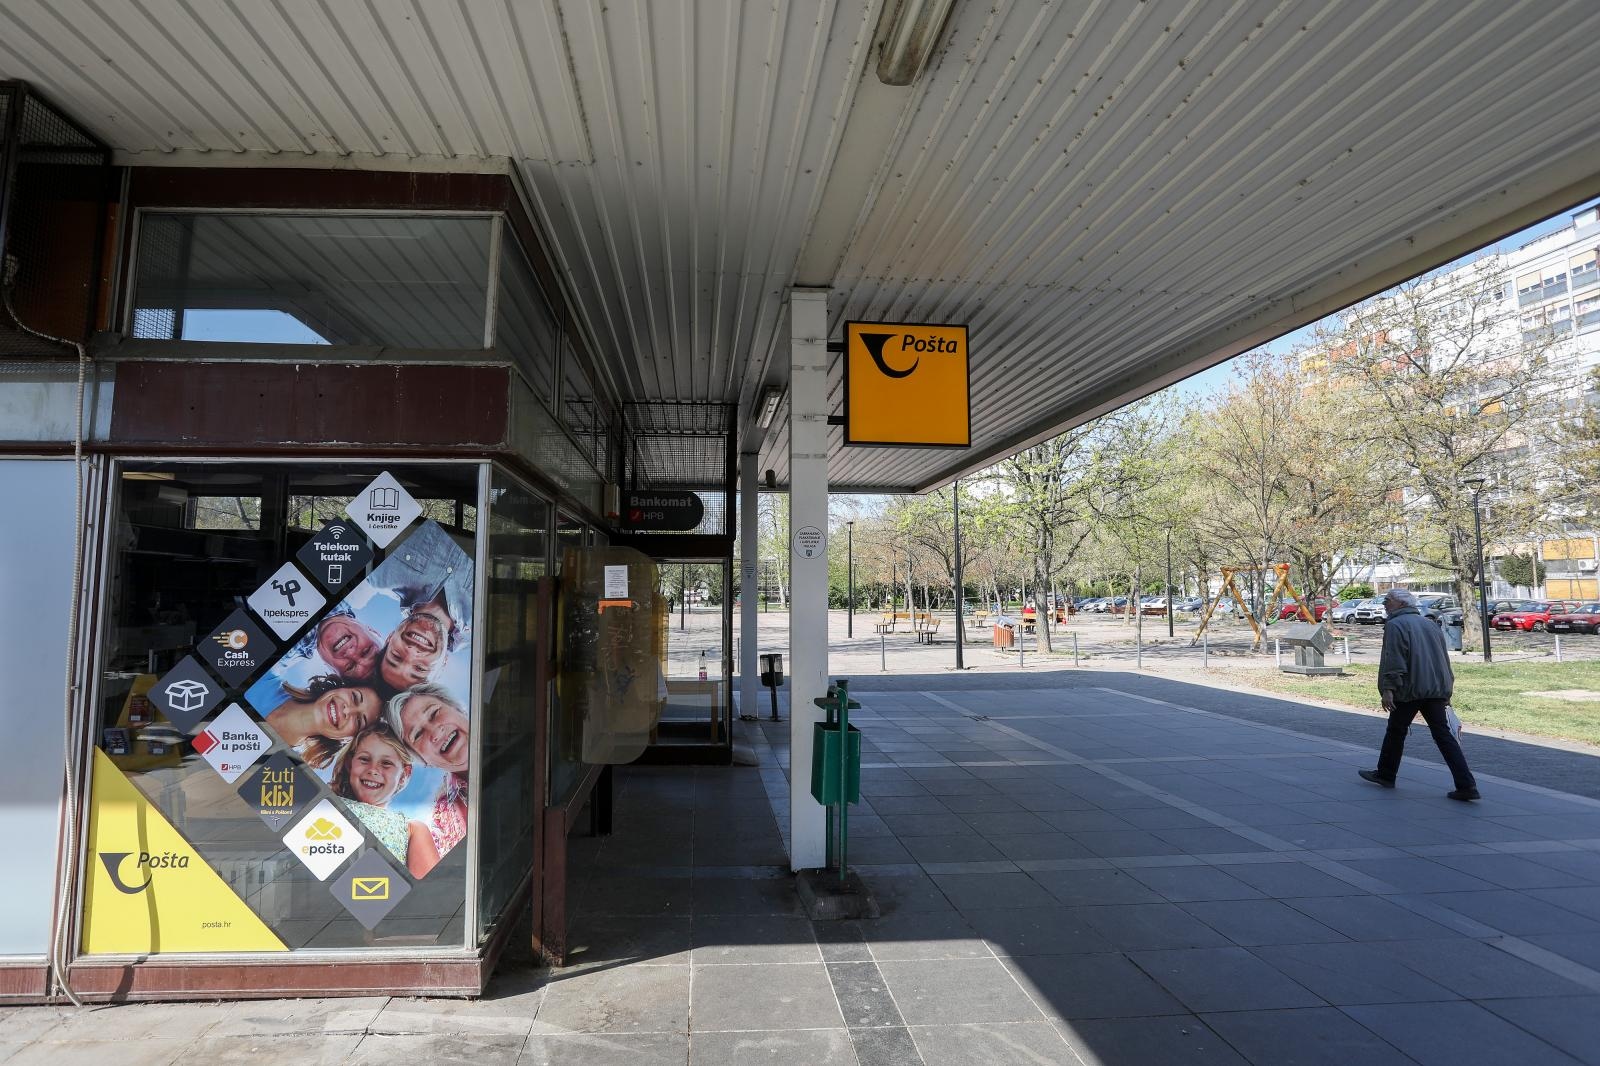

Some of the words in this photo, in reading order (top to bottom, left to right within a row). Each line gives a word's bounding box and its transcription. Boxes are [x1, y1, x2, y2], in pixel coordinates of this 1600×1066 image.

[902, 334, 958, 354] Pošta
[630, 496, 692, 507] Bankomat
[367, 513, 401, 523] Knjige
[643, 511, 664, 520] HPB
[314, 542, 360, 551] Telekom
[320, 552, 352, 561] kutak
[263, 609, 309, 618] hpekspres
[224, 650, 249, 659] Cash
[217, 658, 255, 667] Express
[222, 731, 259, 741] Banka
[221, 743, 229, 751] u
[232, 742, 261, 752] pošti
[262, 766, 294, 783] žuti
[260, 784, 294, 807] klik
[302, 843, 345, 856] epošta
[136, 851, 190, 869] Pošta
[201, 921, 232, 929] posta.hr
